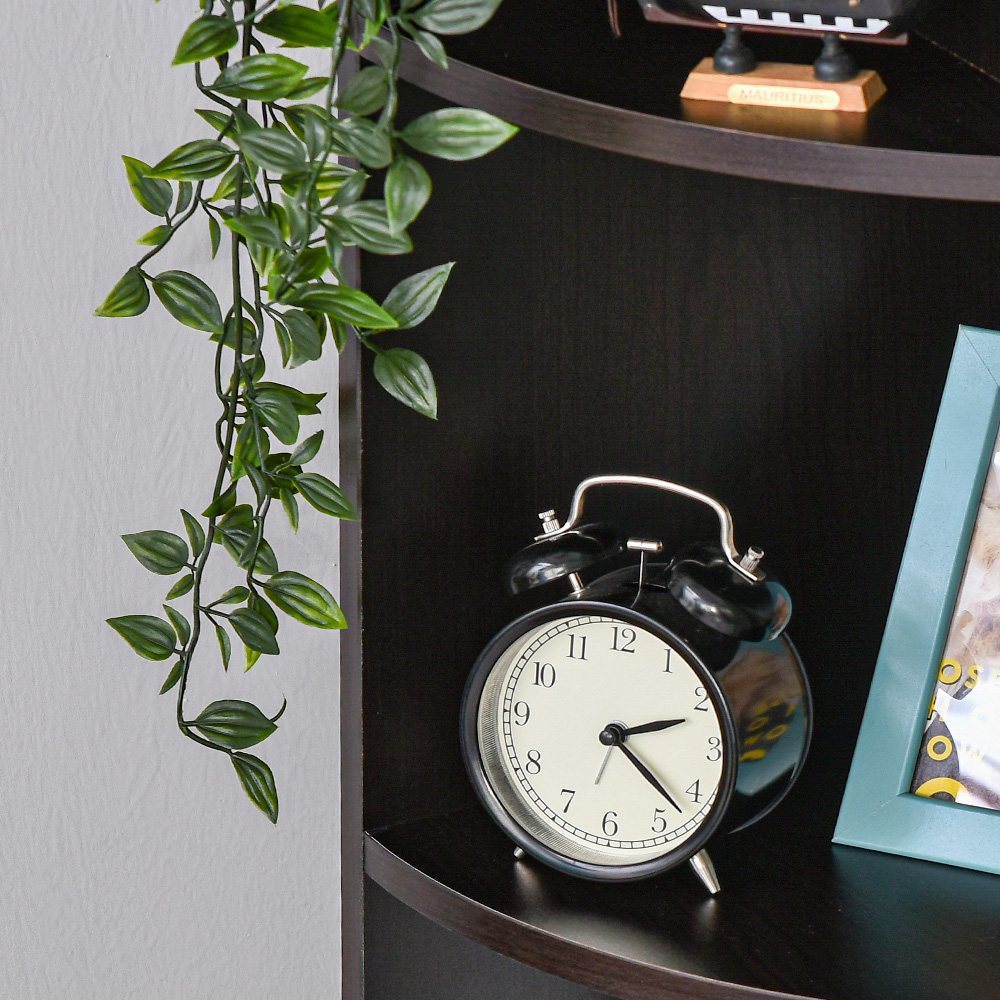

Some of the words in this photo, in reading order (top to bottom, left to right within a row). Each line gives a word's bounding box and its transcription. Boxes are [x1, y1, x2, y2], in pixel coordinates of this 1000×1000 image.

[739, 88, 825, 105] MAURITIUS
[566, 633, 588, 661] 11
[610, 626, 637, 653] 12
[662, 648, 673, 674] 1
[532, 661, 556, 688] 10
[693, 686, 709, 712] 2
[514, 701, 531, 726] 9
[525, 749, 541, 774] 8
[706, 736, 722, 762] 3
[560, 788, 576, 813] 7
[685, 778, 703, 804] 4
[601, 810, 619, 836] 6
[651, 807, 667, 833] 5
